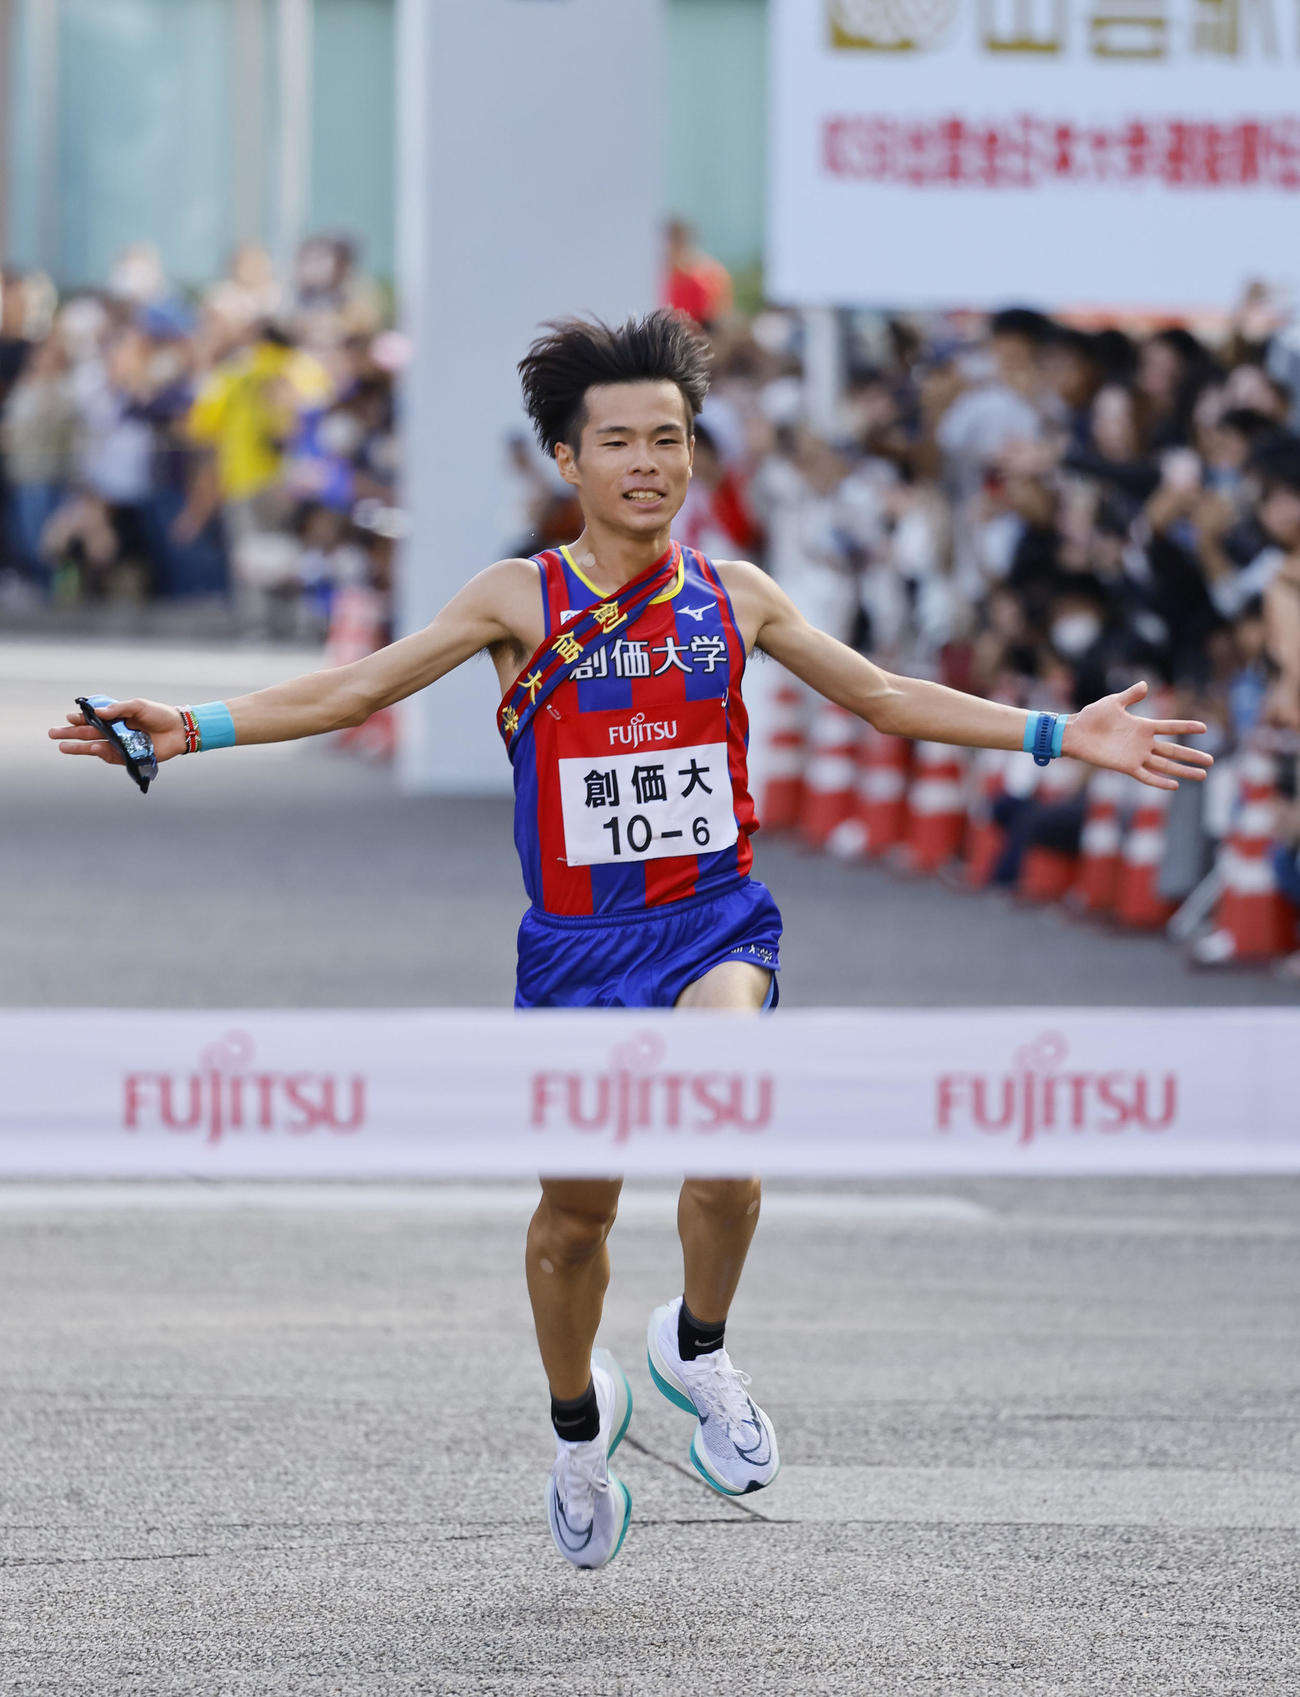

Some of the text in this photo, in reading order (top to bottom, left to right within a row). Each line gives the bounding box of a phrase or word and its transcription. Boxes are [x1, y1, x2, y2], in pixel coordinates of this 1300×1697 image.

[608, 712, 678, 749] FUJITSU
[583, 758, 714, 809] 創価大
[602, 813, 711, 856] 10-6
[122, 1029, 368, 1147] FUJITSU
[530, 1030, 775, 1146] FUJITSU
[935, 1030, 1178, 1147] FUJITSU
